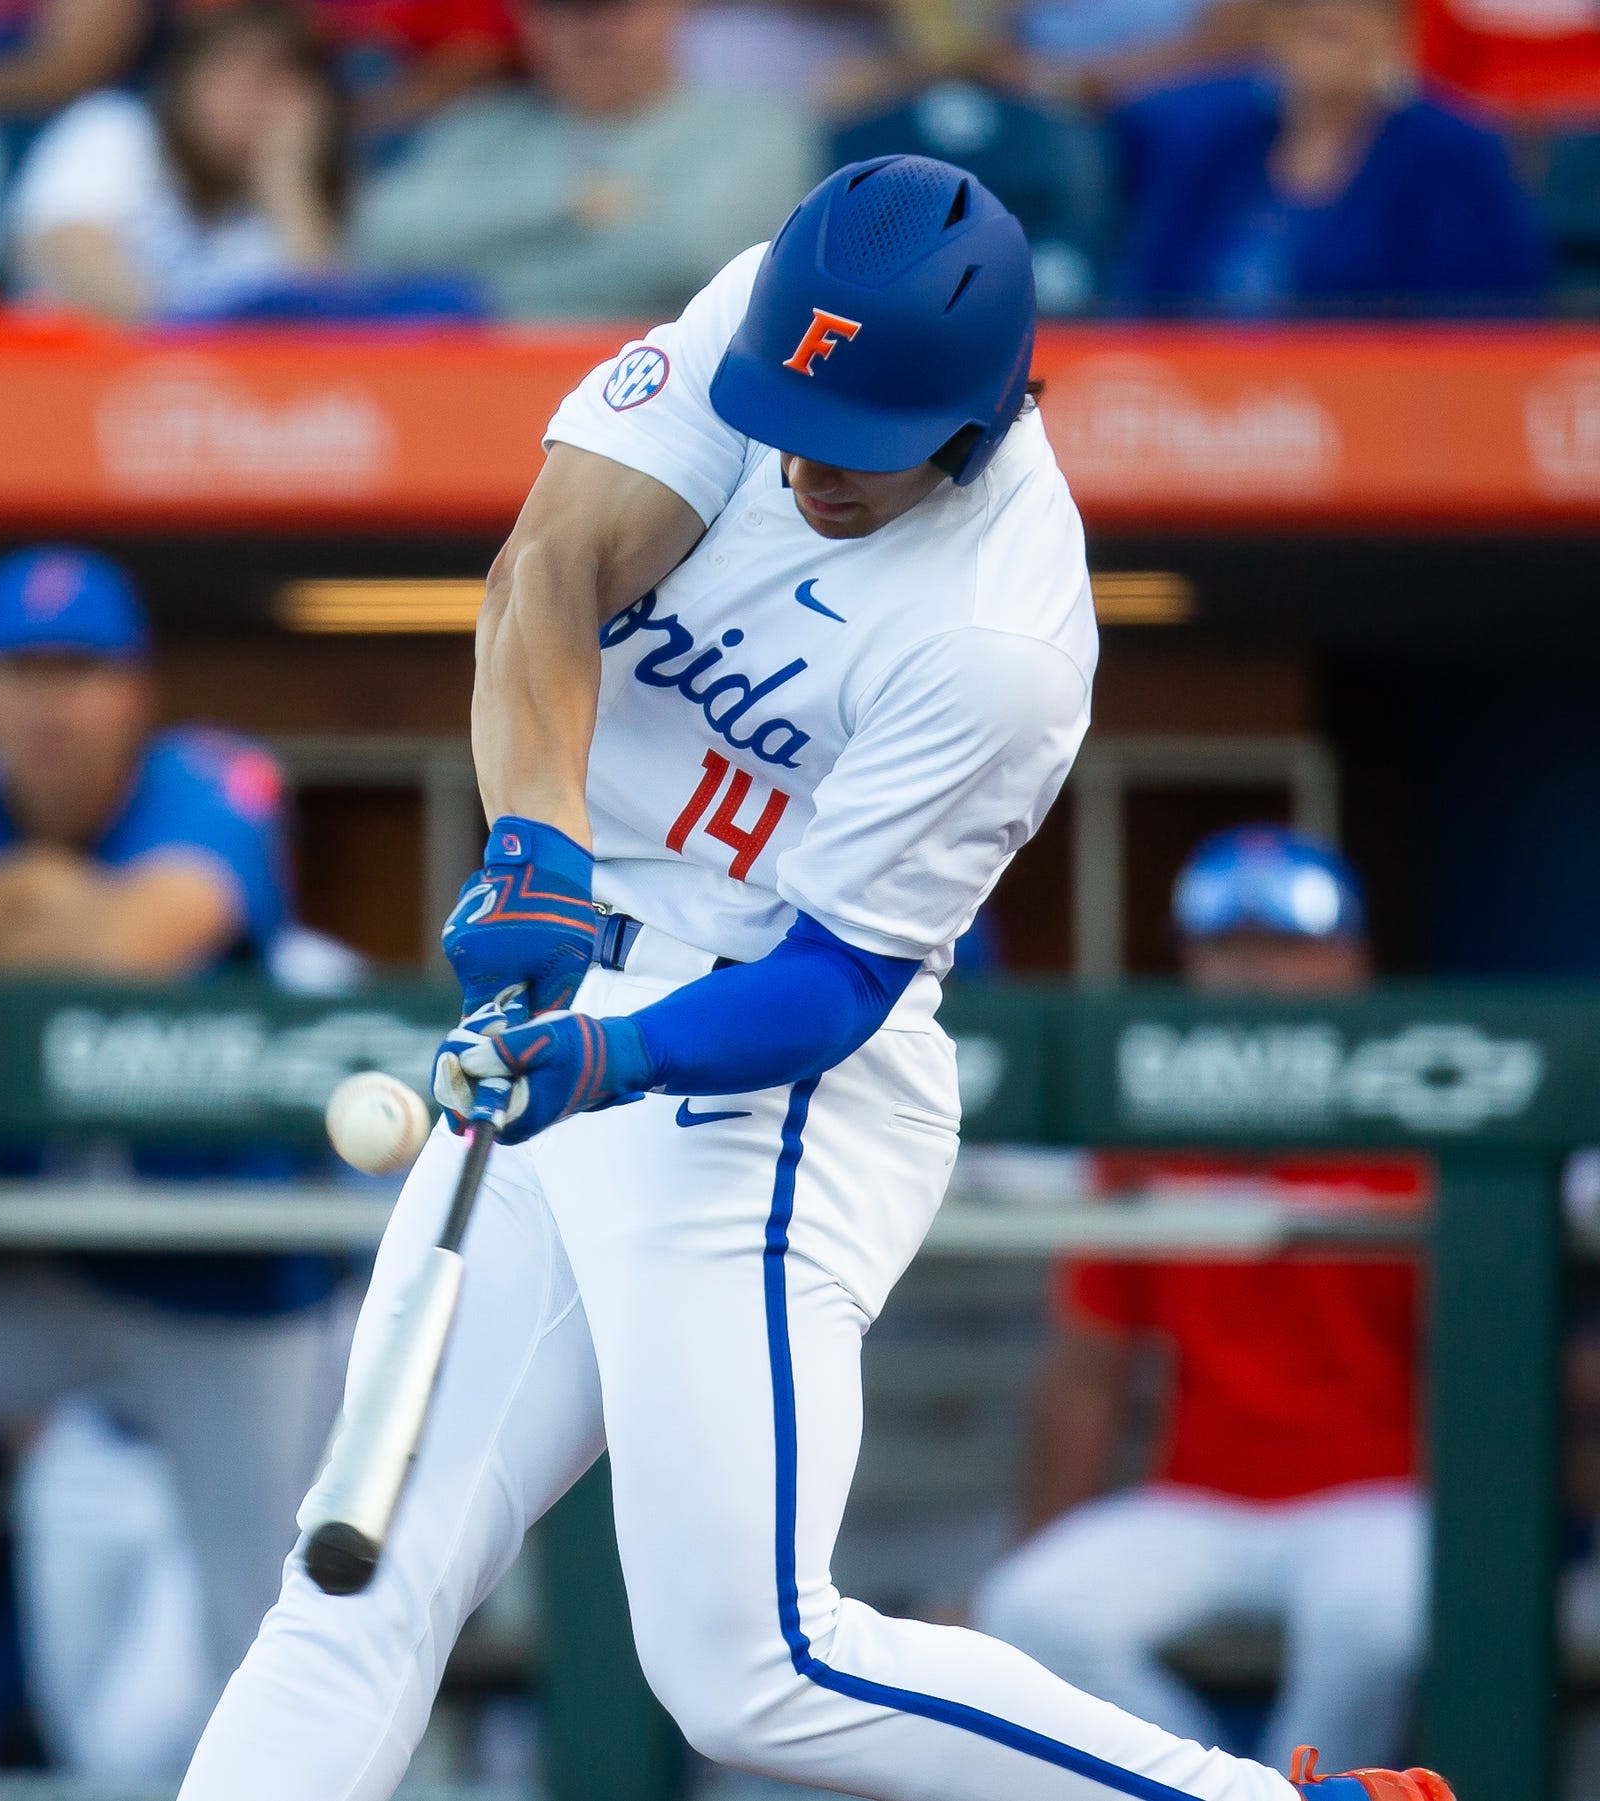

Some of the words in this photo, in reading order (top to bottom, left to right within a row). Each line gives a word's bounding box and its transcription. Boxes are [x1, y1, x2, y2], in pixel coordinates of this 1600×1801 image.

[604, 348, 667, 410] SEC
[782, 307, 862, 376] F
[598, 587, 812, 769] orida
[665, 747, 791, 882] 14
